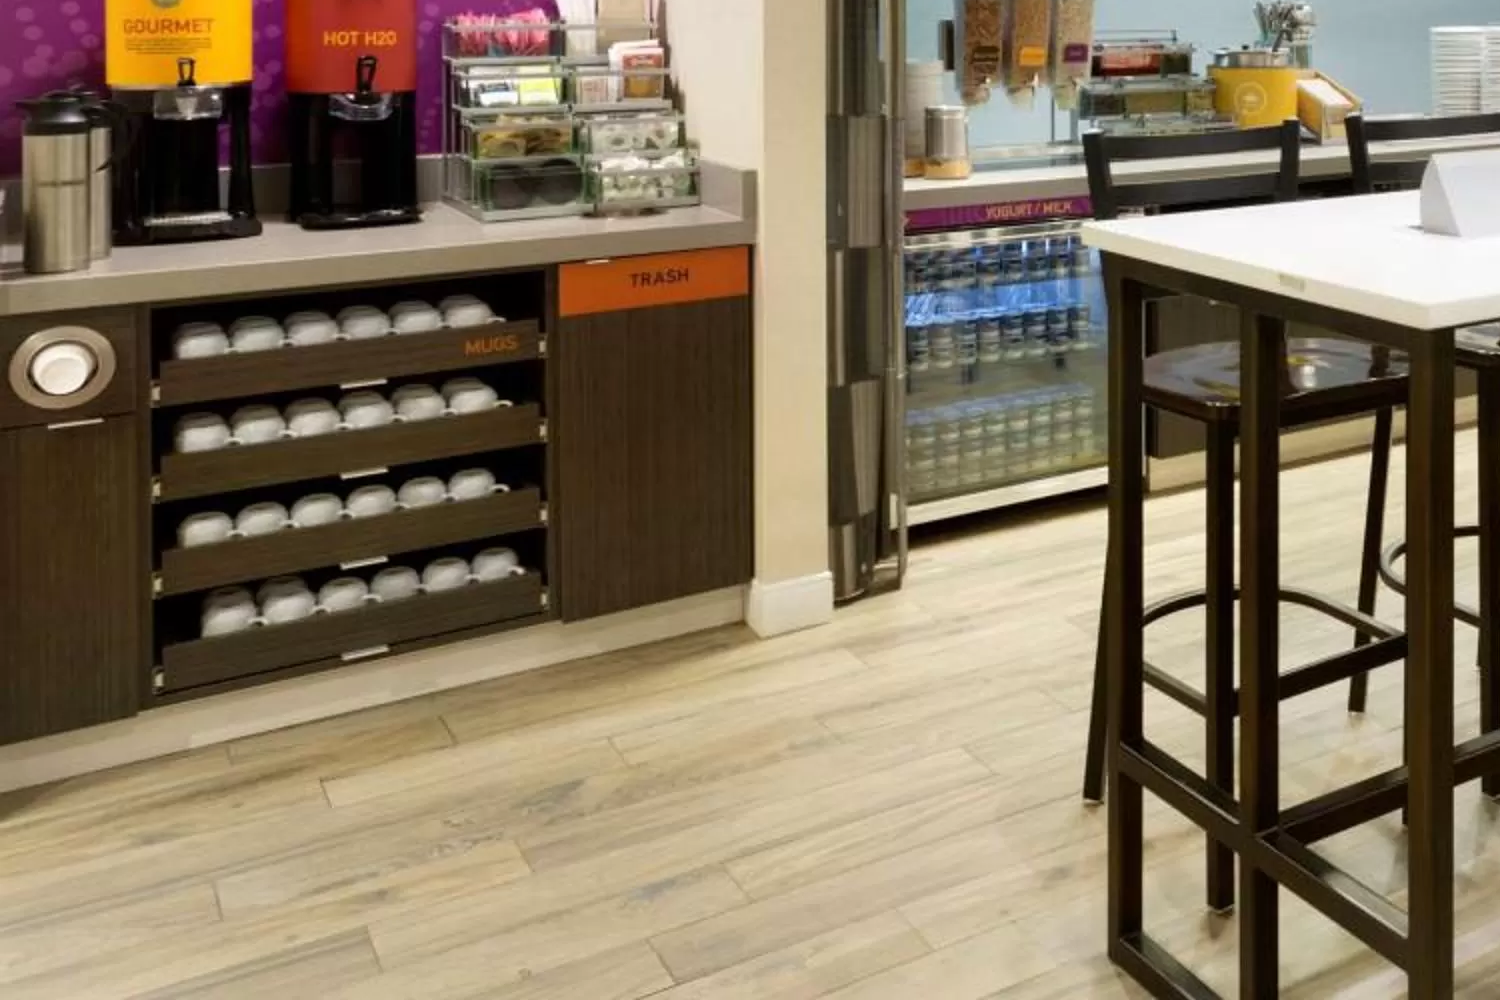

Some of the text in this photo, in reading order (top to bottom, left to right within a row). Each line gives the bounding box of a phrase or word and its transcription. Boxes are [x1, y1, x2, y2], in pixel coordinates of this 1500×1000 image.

[123, 17, 214, 35] GOURMET
[323, 30, 359, 47] HOT
[985, 203, 1033, 220] YOGURT
[629, 267, 690, 289] TRASH
[464, 333, 519, 357] MUGS
